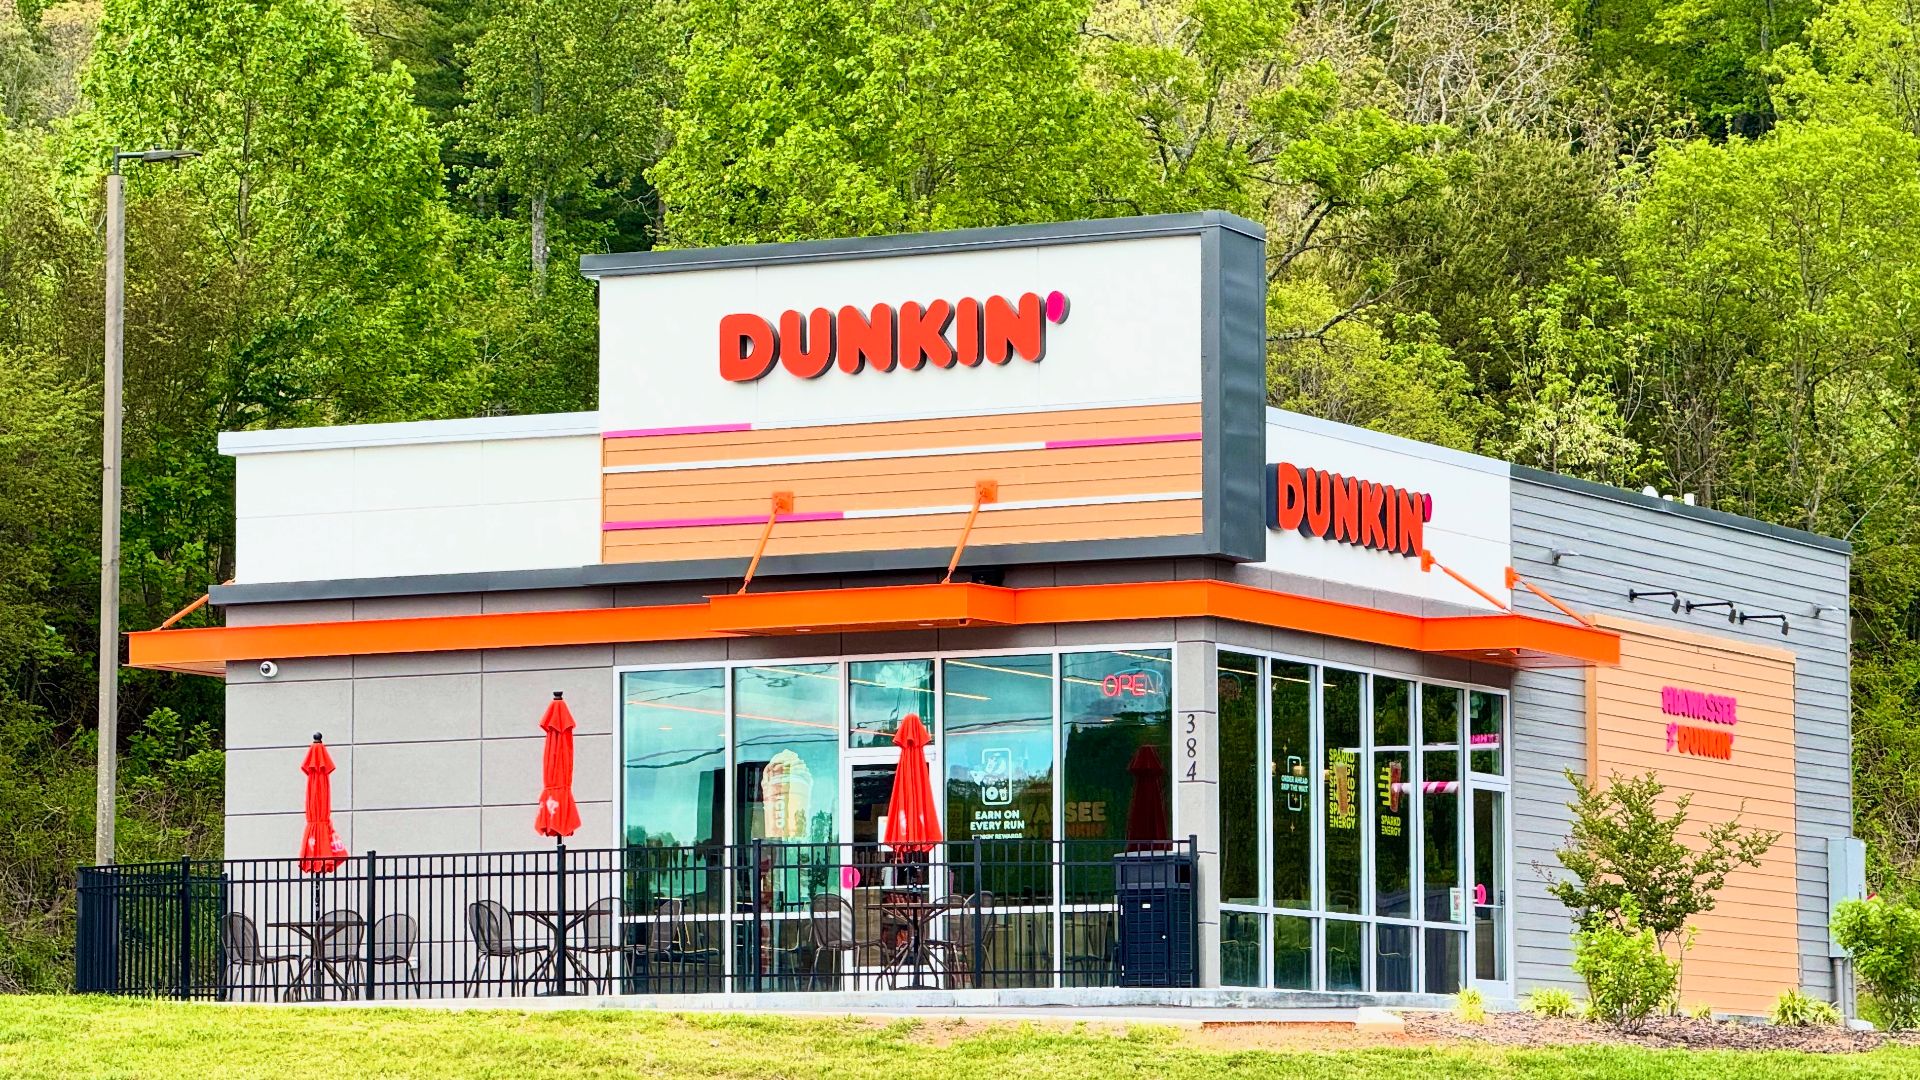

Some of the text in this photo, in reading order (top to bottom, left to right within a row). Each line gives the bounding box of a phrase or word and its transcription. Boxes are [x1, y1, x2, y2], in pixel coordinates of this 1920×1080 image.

[719, 290, 1069, 382] DUNKIN'
[1276, 462, 1432, 557] DUNKIN'
[1103, 673, 1159, 697] OPEN
[1186, 713, 1197, 781] 384
[970, 820, 1025, 831] EVERY RUN
[975, 809, 1020, 820] EARN ON
[1329, 815, 1356, 830] ENERGY
